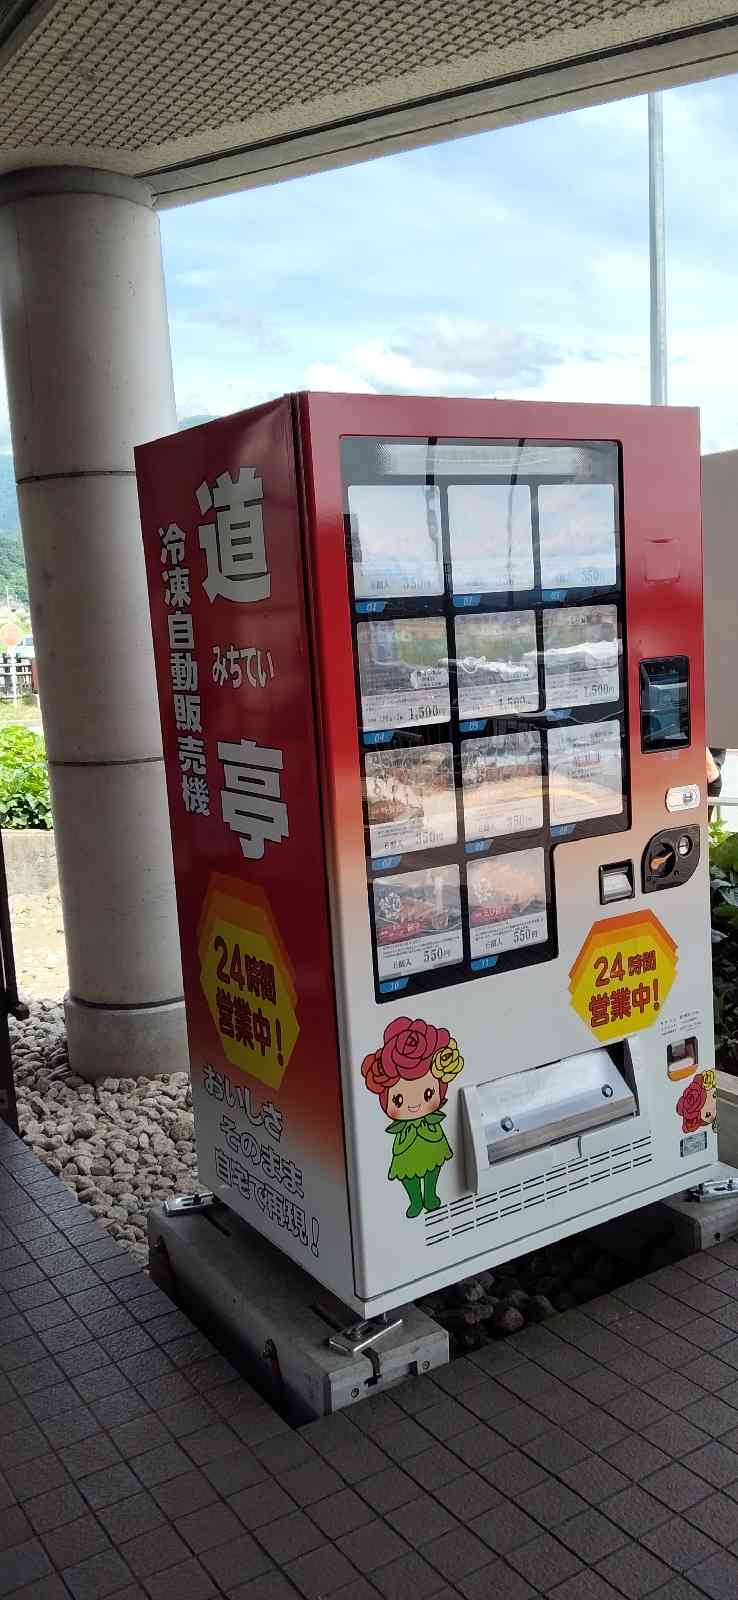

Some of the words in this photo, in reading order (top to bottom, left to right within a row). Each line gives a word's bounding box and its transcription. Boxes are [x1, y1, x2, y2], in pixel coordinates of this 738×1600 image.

[157, 523, 211, 817] 冷凍自動販売機
[211, 645, 274, 689] みちてい
[213, 934, 278, 1006] 24時間
[423, 946, 451, 963] 550円
[512, 929, 538, 945] 550円
[592, 949, 657, 988] 24時間
[215, 986, 285, 1068] 営業中!
[588, 978, 661, 1029] 営業中!
[203, 1062, 285, 1143] おいしさ
[219, 1114, 306, 1199] そのまま
[213, 1146, 320, 1259] 自宅で再現!
